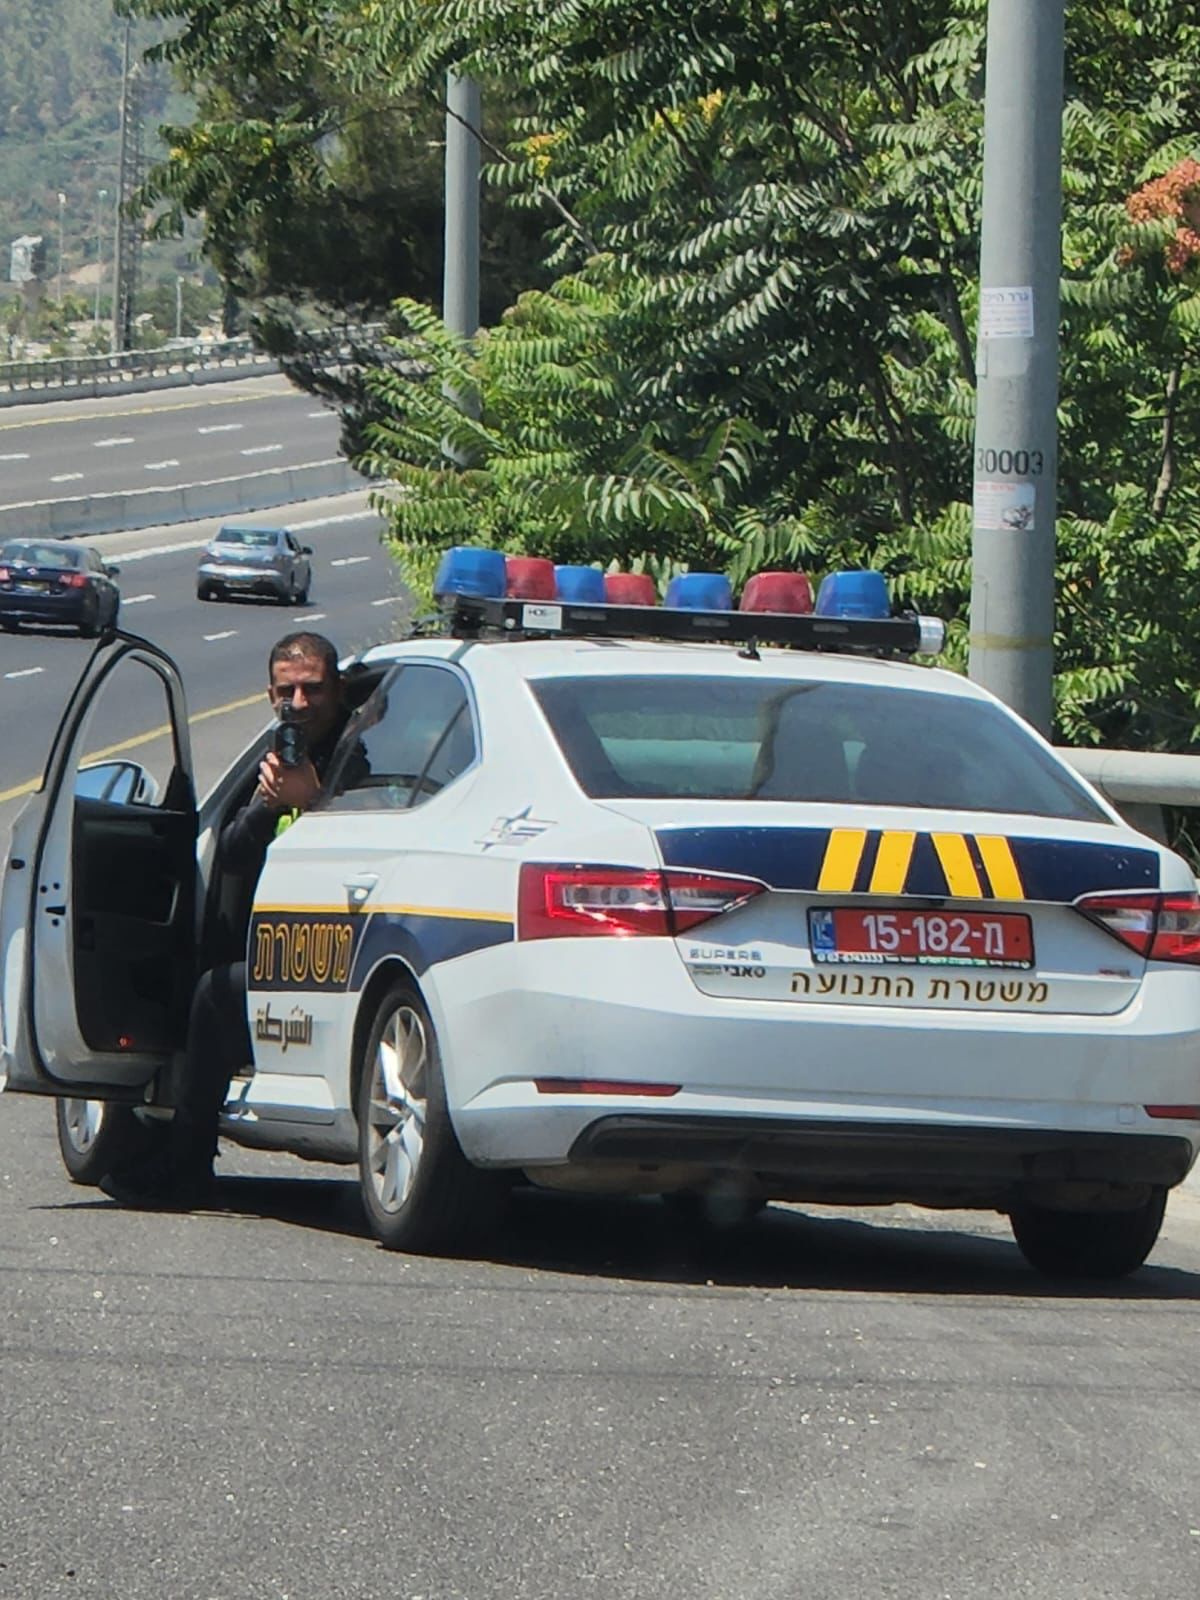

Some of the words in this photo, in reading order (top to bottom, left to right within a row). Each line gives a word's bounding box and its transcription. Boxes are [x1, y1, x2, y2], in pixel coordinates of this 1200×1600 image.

[976, 447, 1044, 475] 30003
[253, 922, 353, 983] משטרת
[791, 971, 914, 998] התנועה
[927, 979, 1049, 1003] משטרת
[256, 1002, 313, 1053] الشرطة
